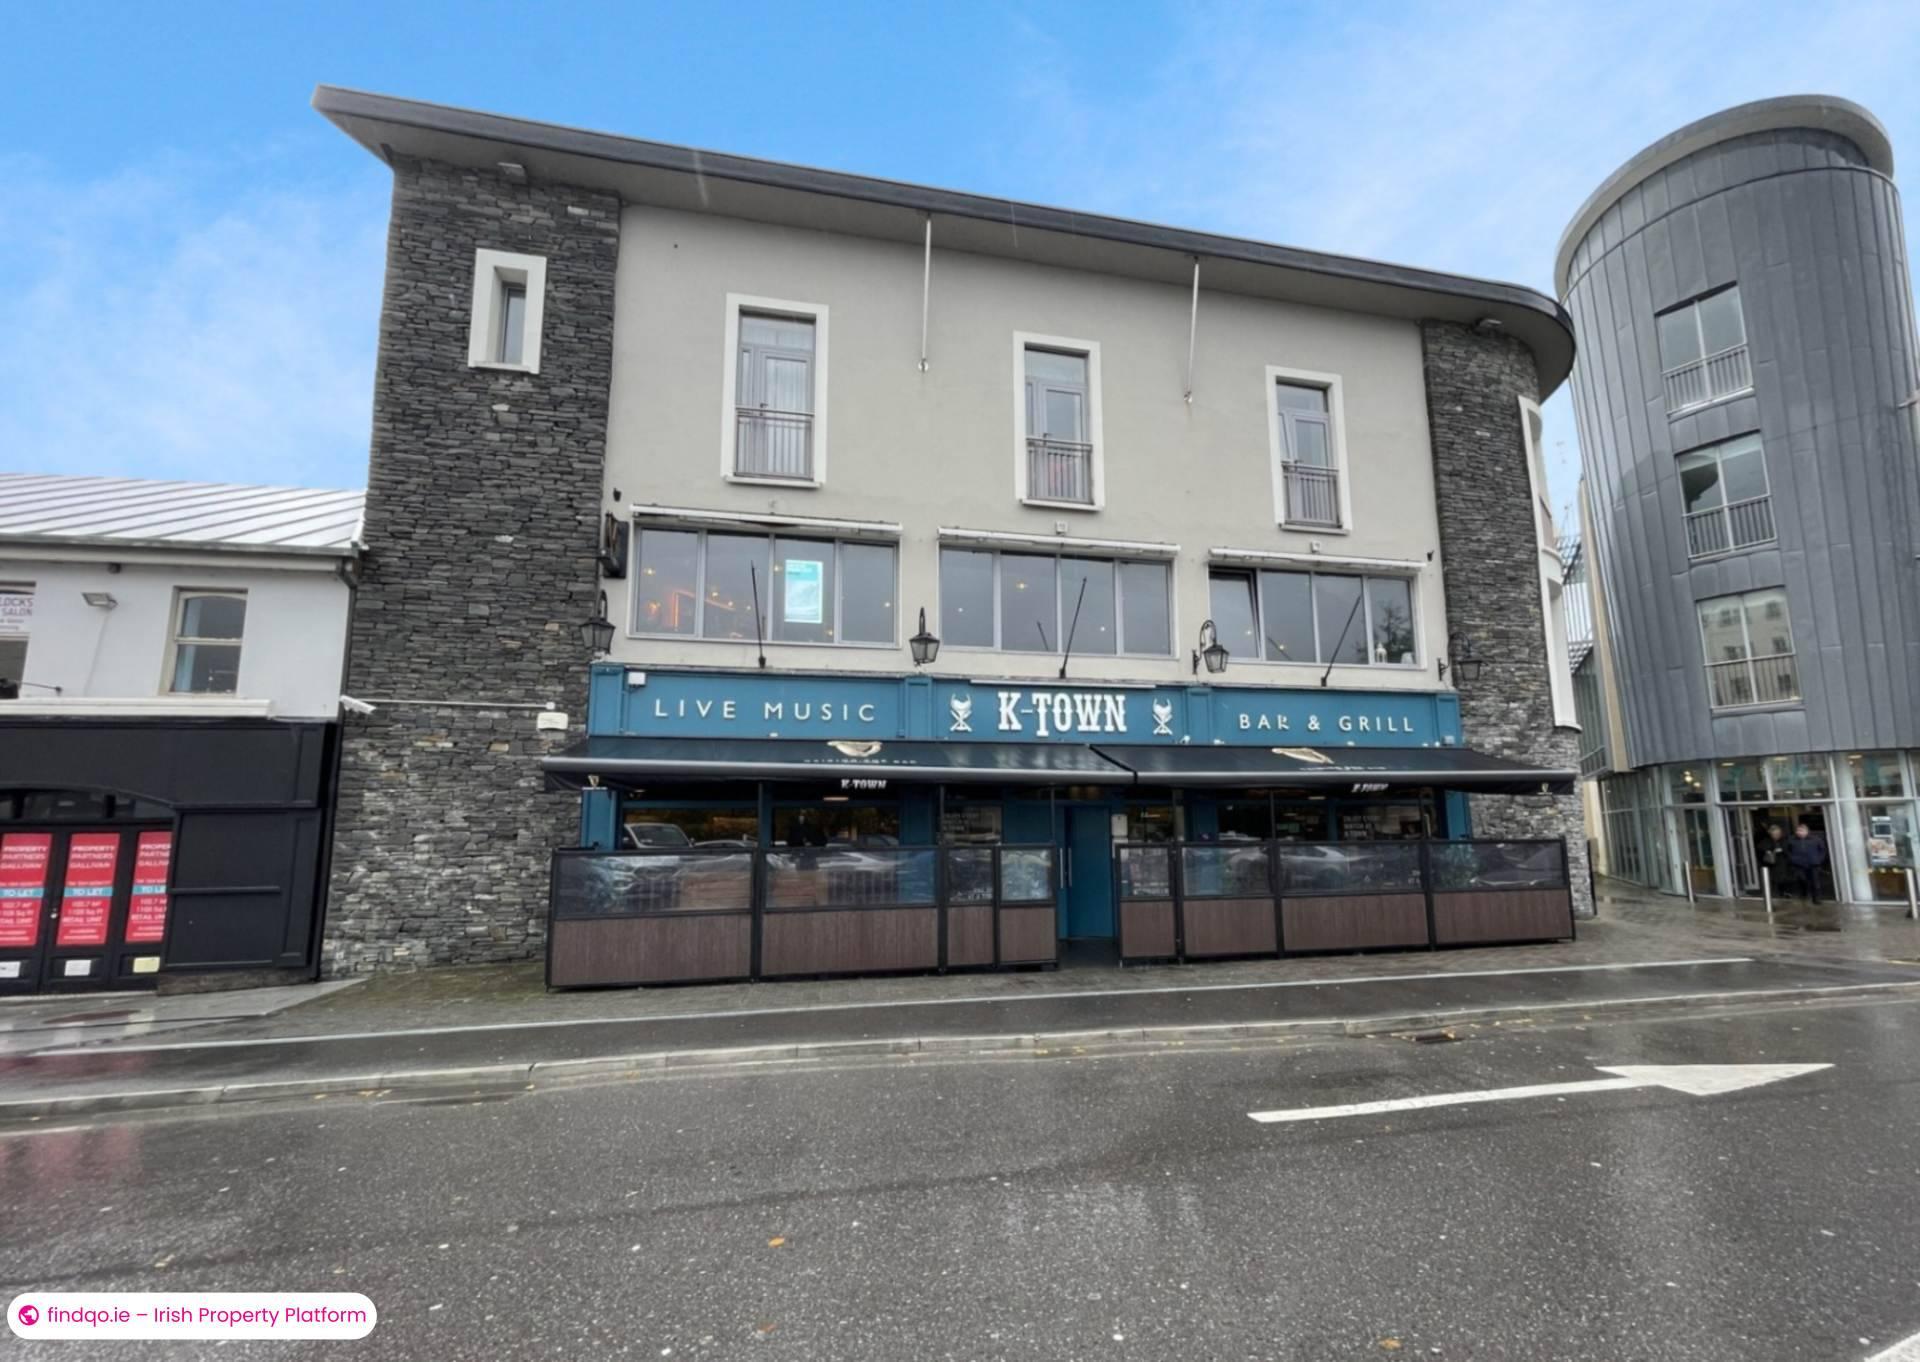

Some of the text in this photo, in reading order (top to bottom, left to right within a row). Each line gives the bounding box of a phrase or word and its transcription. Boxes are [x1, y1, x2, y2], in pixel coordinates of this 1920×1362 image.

[655, 698, 875, 722] LIVE MUSIC
[998, 691, 1127, 737] K-TOWN
[1239, 713, 1414, 732] BAR & GRILL
[841, 779, 887, 790] K-TOWN
